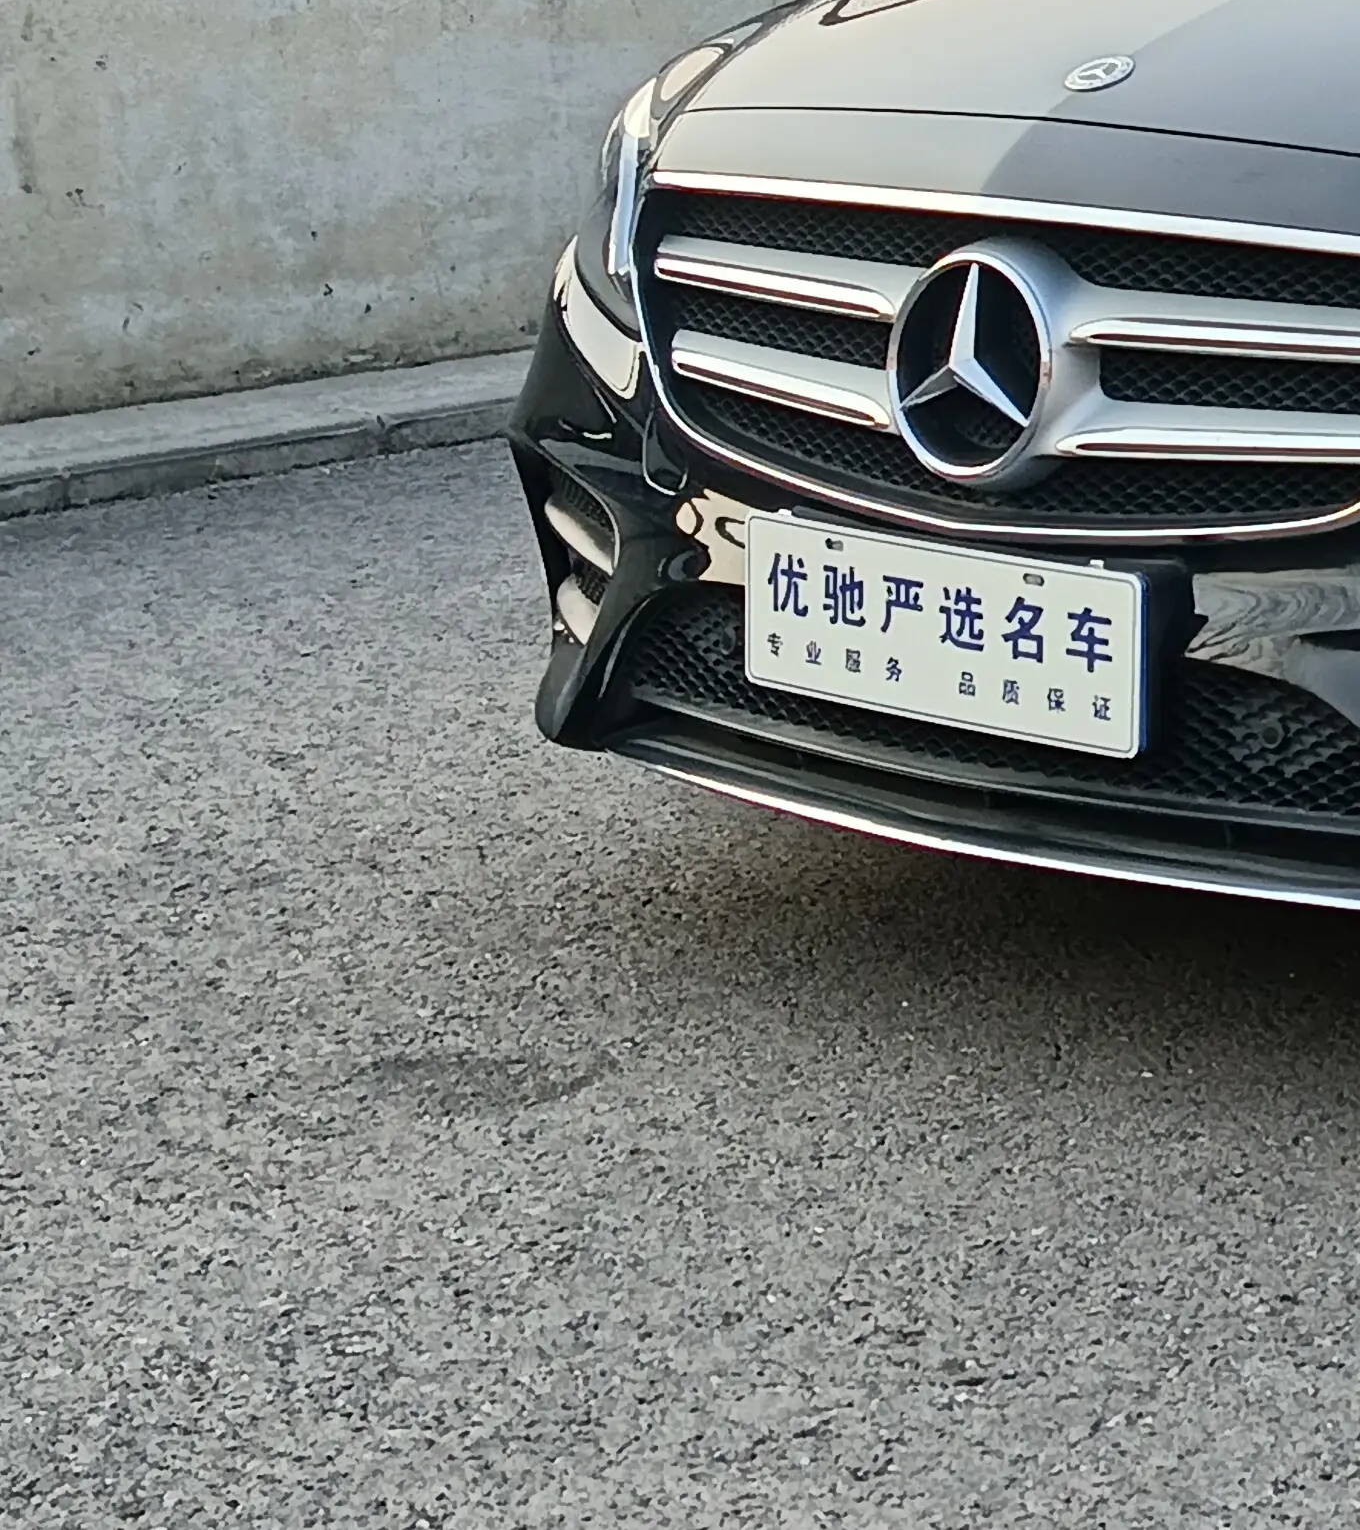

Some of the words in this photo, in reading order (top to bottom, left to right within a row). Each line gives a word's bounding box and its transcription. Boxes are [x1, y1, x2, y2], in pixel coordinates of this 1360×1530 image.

[767, 551, 1113, 673] 优驰严选名车
[767, 632, 903, 683] 专业服务
[958, 671, 1112, 722] 品质保证
